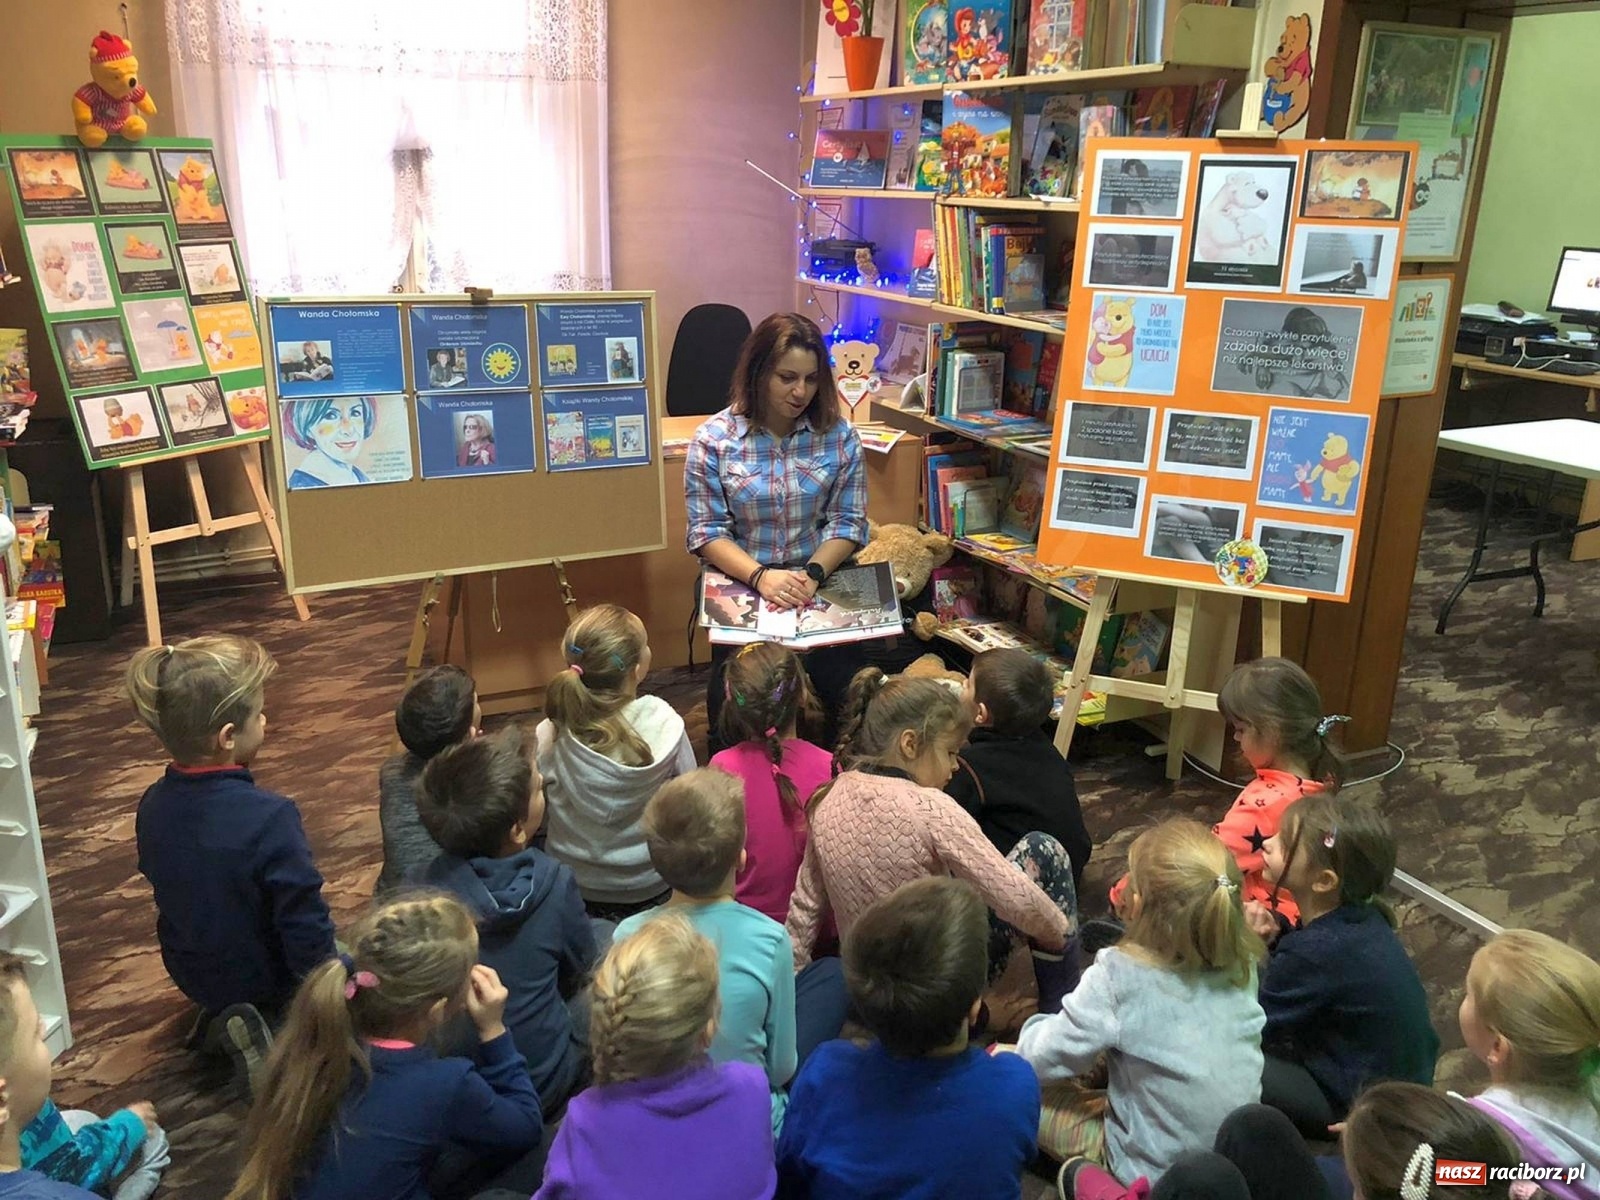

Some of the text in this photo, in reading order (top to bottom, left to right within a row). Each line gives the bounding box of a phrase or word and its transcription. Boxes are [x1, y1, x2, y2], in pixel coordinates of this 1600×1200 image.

[298, 310, 330, 319] Wanda
[1150, 303, 1167, 317] DOM
[1223, 327, 1354, 345] Czasami zwykłe przytulenie
[1223, 341, 1351, 362] zdziała dużo więcej
[1222, 354, 1348, 373] niż najlepsze lekarstwa.
[1272, 415, 1310, 428] NIE JEST
